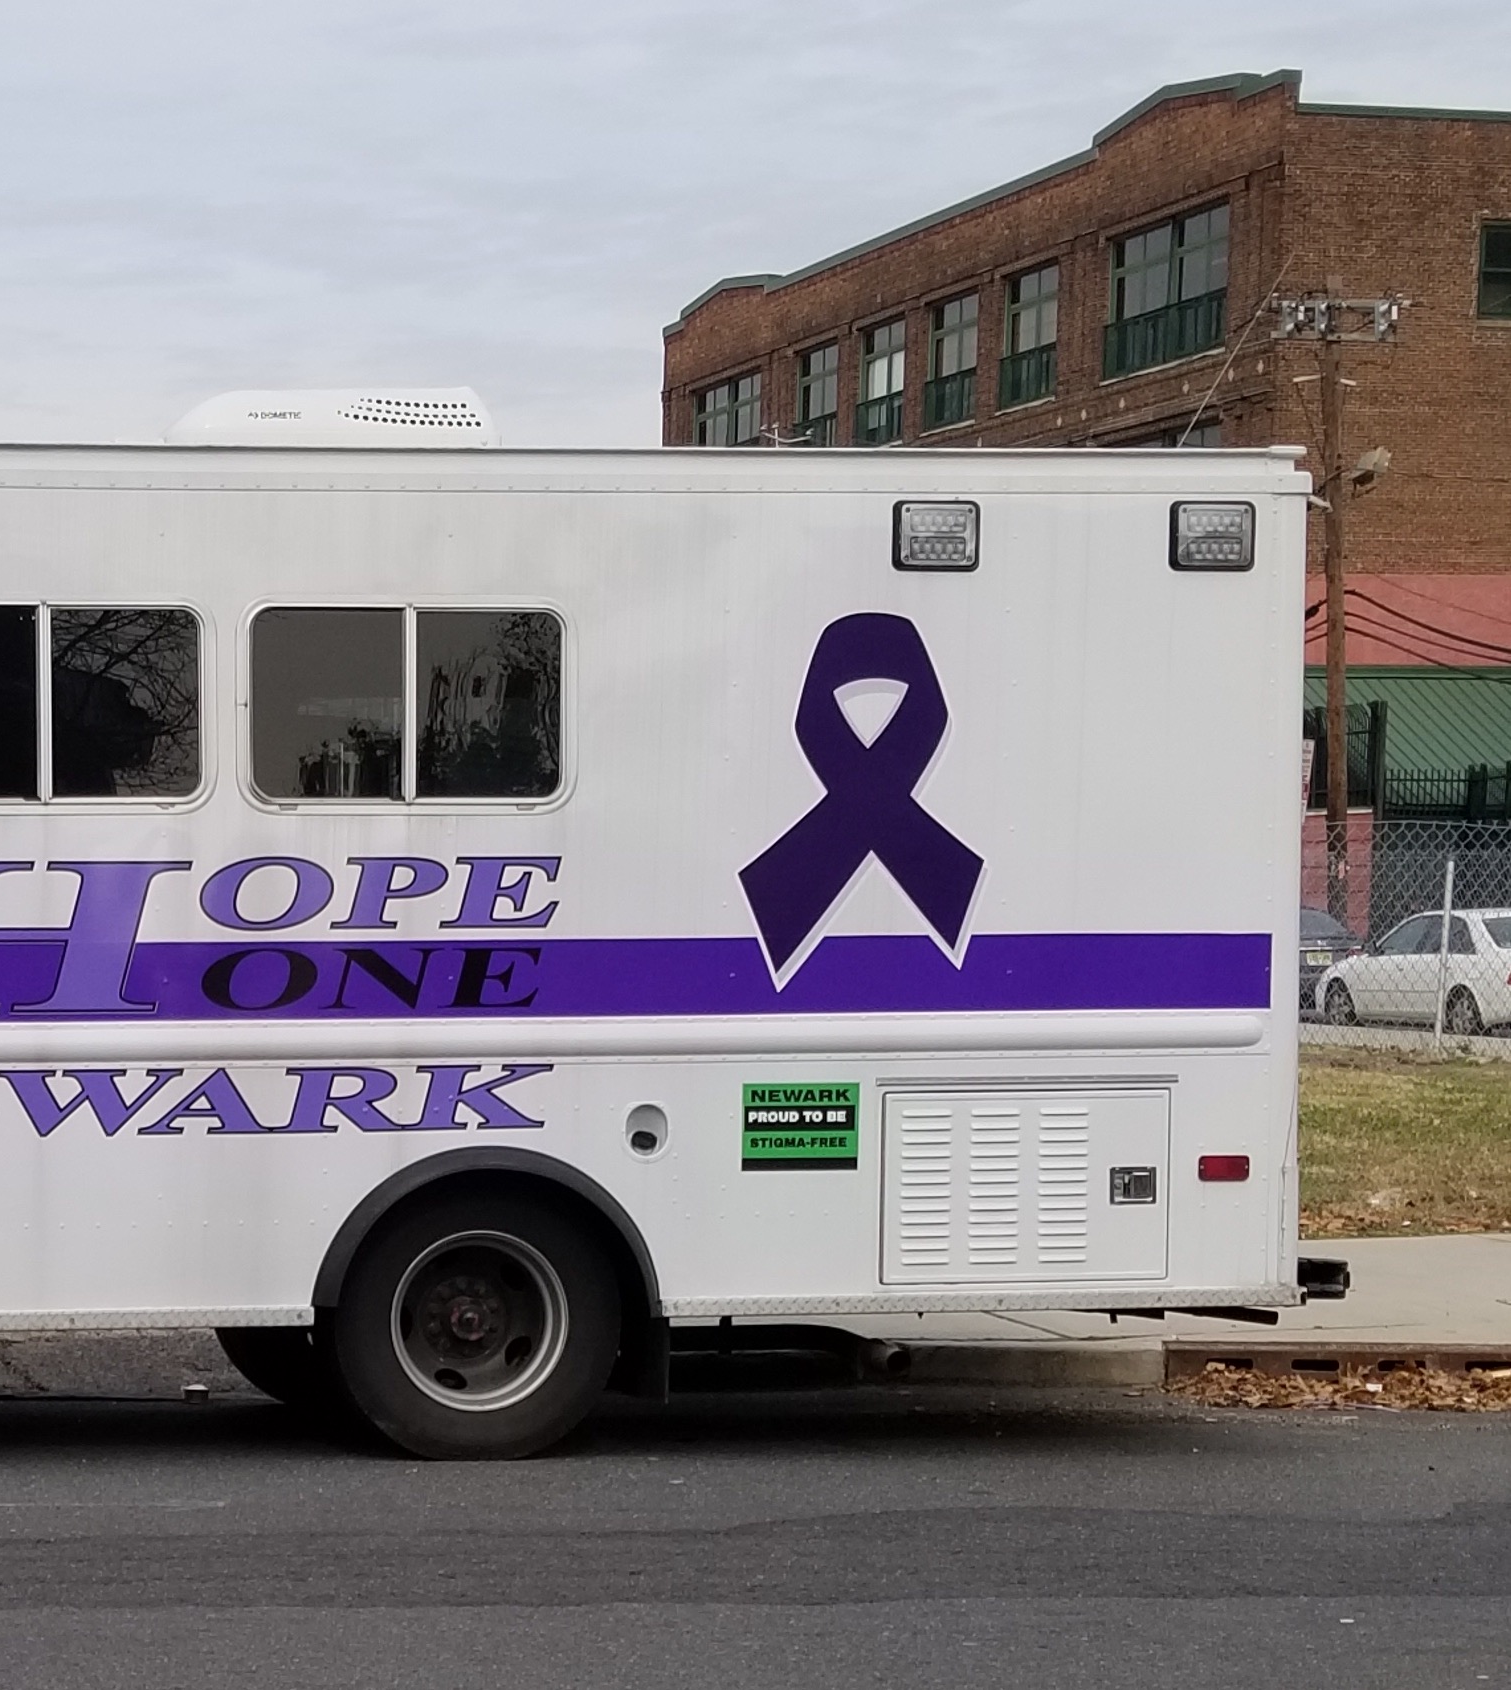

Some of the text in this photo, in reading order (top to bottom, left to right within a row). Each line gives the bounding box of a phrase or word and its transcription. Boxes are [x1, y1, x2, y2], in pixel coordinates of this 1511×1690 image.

[200, 947, 544, 1011] ONE
[750, 1088, 851, 1103] NEWARK
[748, 1110, 847, 1123] PROUD TO BE
[749, 1136, 848, 1149] STIGMA-FREE
